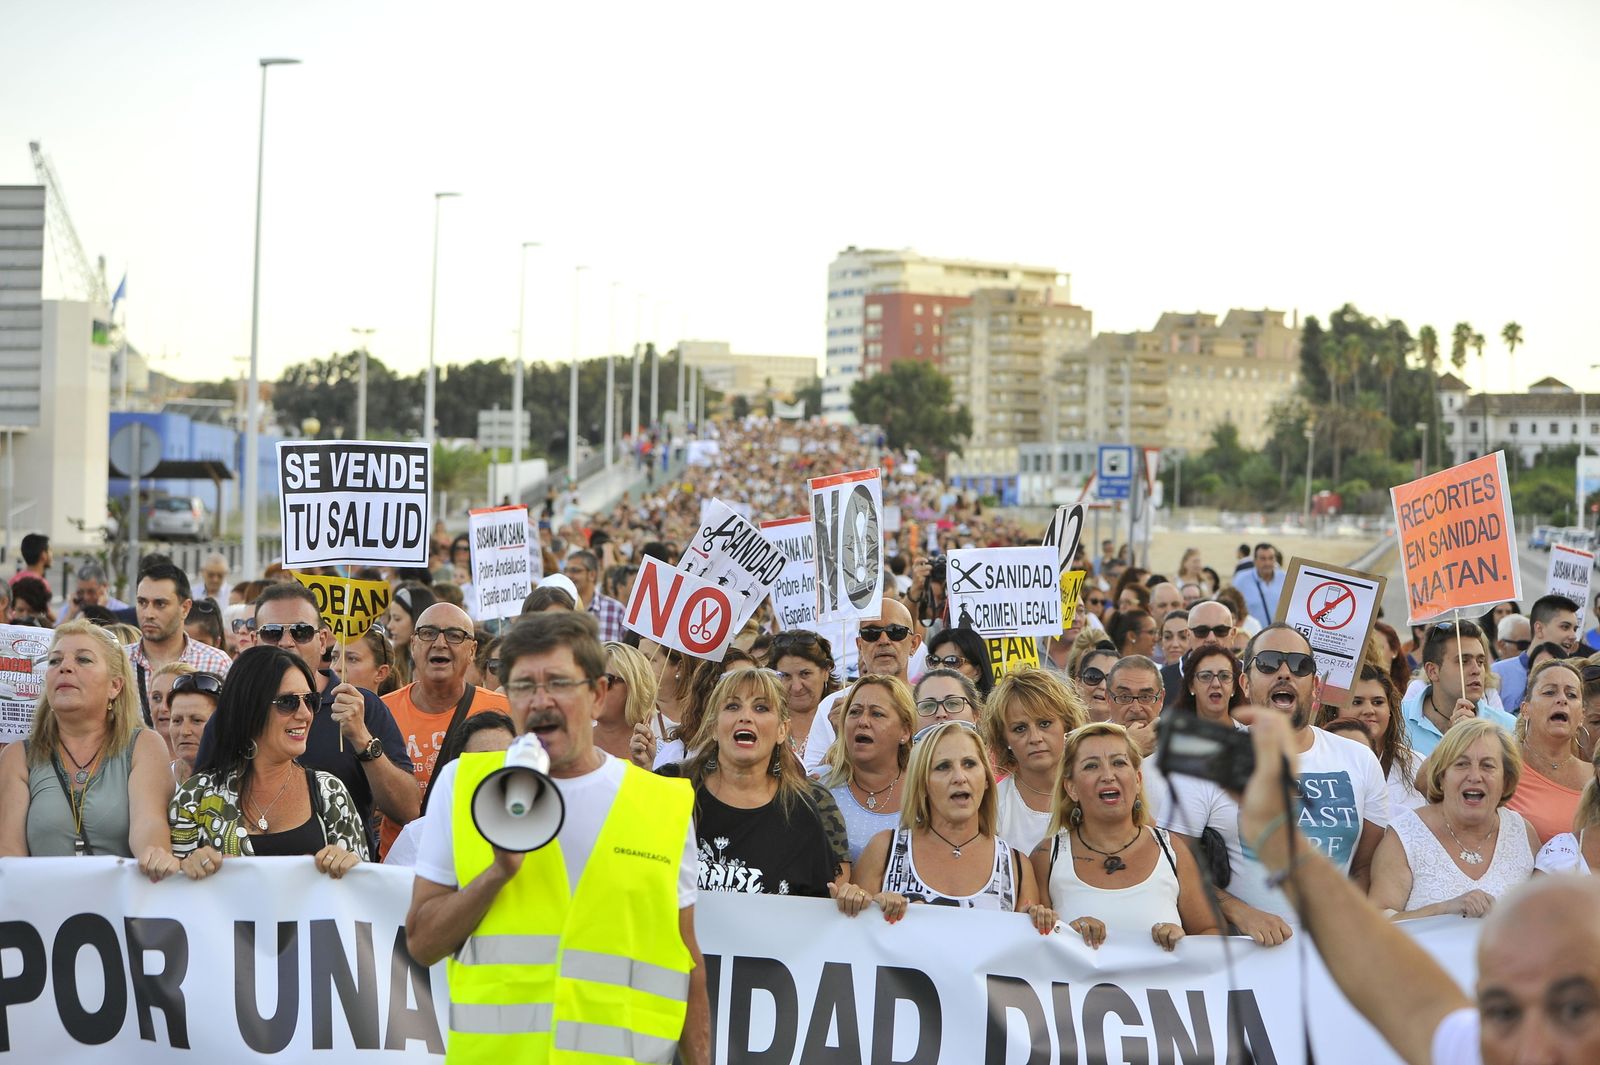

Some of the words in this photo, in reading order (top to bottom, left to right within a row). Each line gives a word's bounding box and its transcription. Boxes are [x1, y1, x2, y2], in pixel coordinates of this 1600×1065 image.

[285, 452, 320, 489] SE
[330, 452, 425, 490] VENDE
[1400, 472, 1496, 531] RECORTES
[289, 502, 321, 551] TU
[326, 501, 422, 549] SALUD
[476, 524, 497, 549] SUSANA
[498, 523, 507, 546] NO
[1405, 537, 1426, 570] EN
[1428, 513, 1501, 559] SANIDAD
[720, 520, 787, 586] SANIDAD
[773, 538, 801, 562] SANA
[802, 534, 813, 560] NO
[814, 484, 879, 615] NO
[495, 555, 527, 577] Andalucía
[985, 564, 1057, 593] SANIDAD,
[1411, 554, 1508, 610] MATAN.
[304, 581, 389, 617] OBAN
[483, 586, 500, 608] España
[501, 587, 511, 603] con
[774, 576, 799, 603] ¡Pobre
[628, 561, 732, 654] NO
[784, 602, 811, 628] España
[974, 603, 1018, 629] CRIMEN
[1020, 601, 1058, 626] LEGAL!
[988, 635, 1035, 664] BAN
[1296, 806, 1356, 829] AST
[0, 912, 190, 1051] POR
[233, 918, 446, 1055] UNA
[702, 953, 943, 1065] IDAD
[985, 973, 1278, 1065] DIGNA
